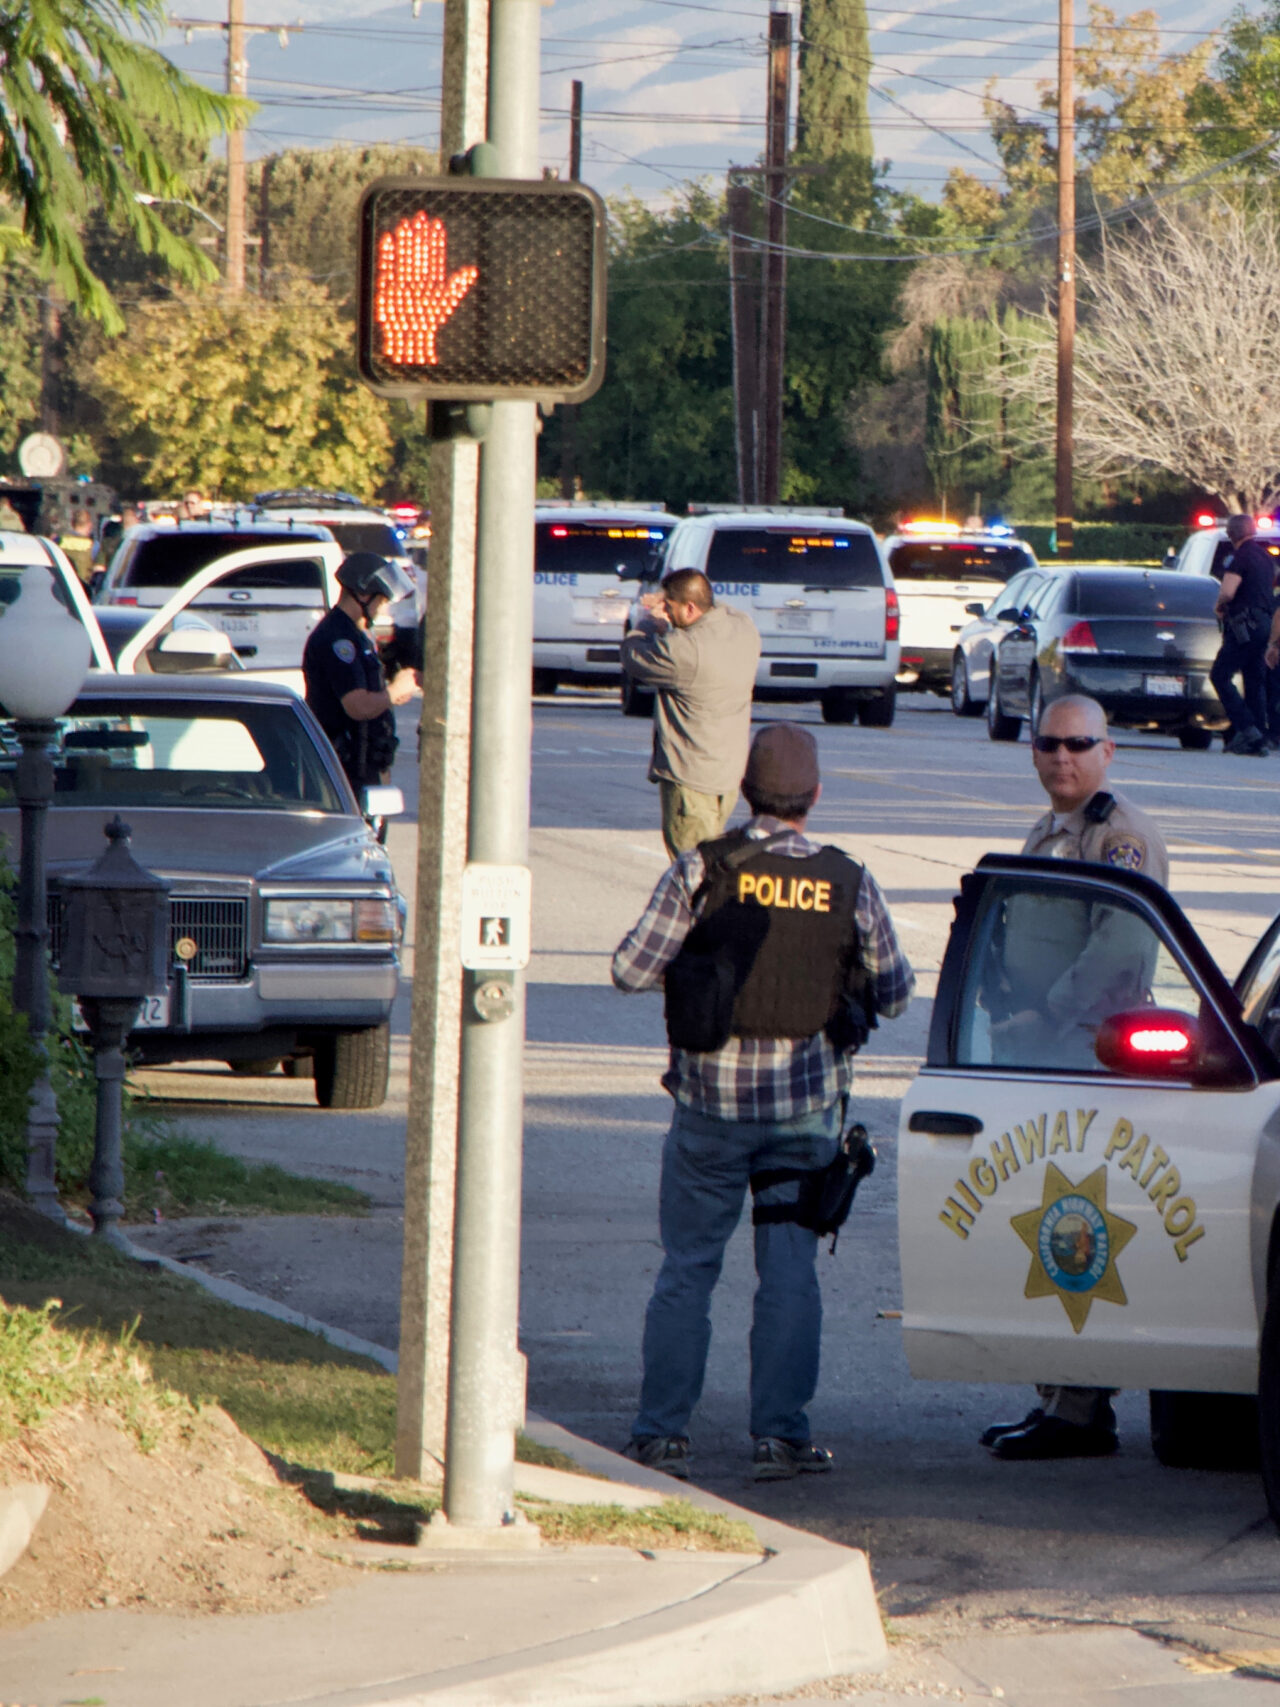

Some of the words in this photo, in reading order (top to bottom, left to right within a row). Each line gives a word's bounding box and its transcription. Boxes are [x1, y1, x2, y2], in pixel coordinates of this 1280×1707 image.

[534, 572, 578, 586] OLICE
[713, 582, 760, 597] OLICE
[738, 872, 832, 912] POLICE
[939, 1109, 1099, 1240] HIGHWAY
[1104, 1117, 1205, 1263] PATROL
